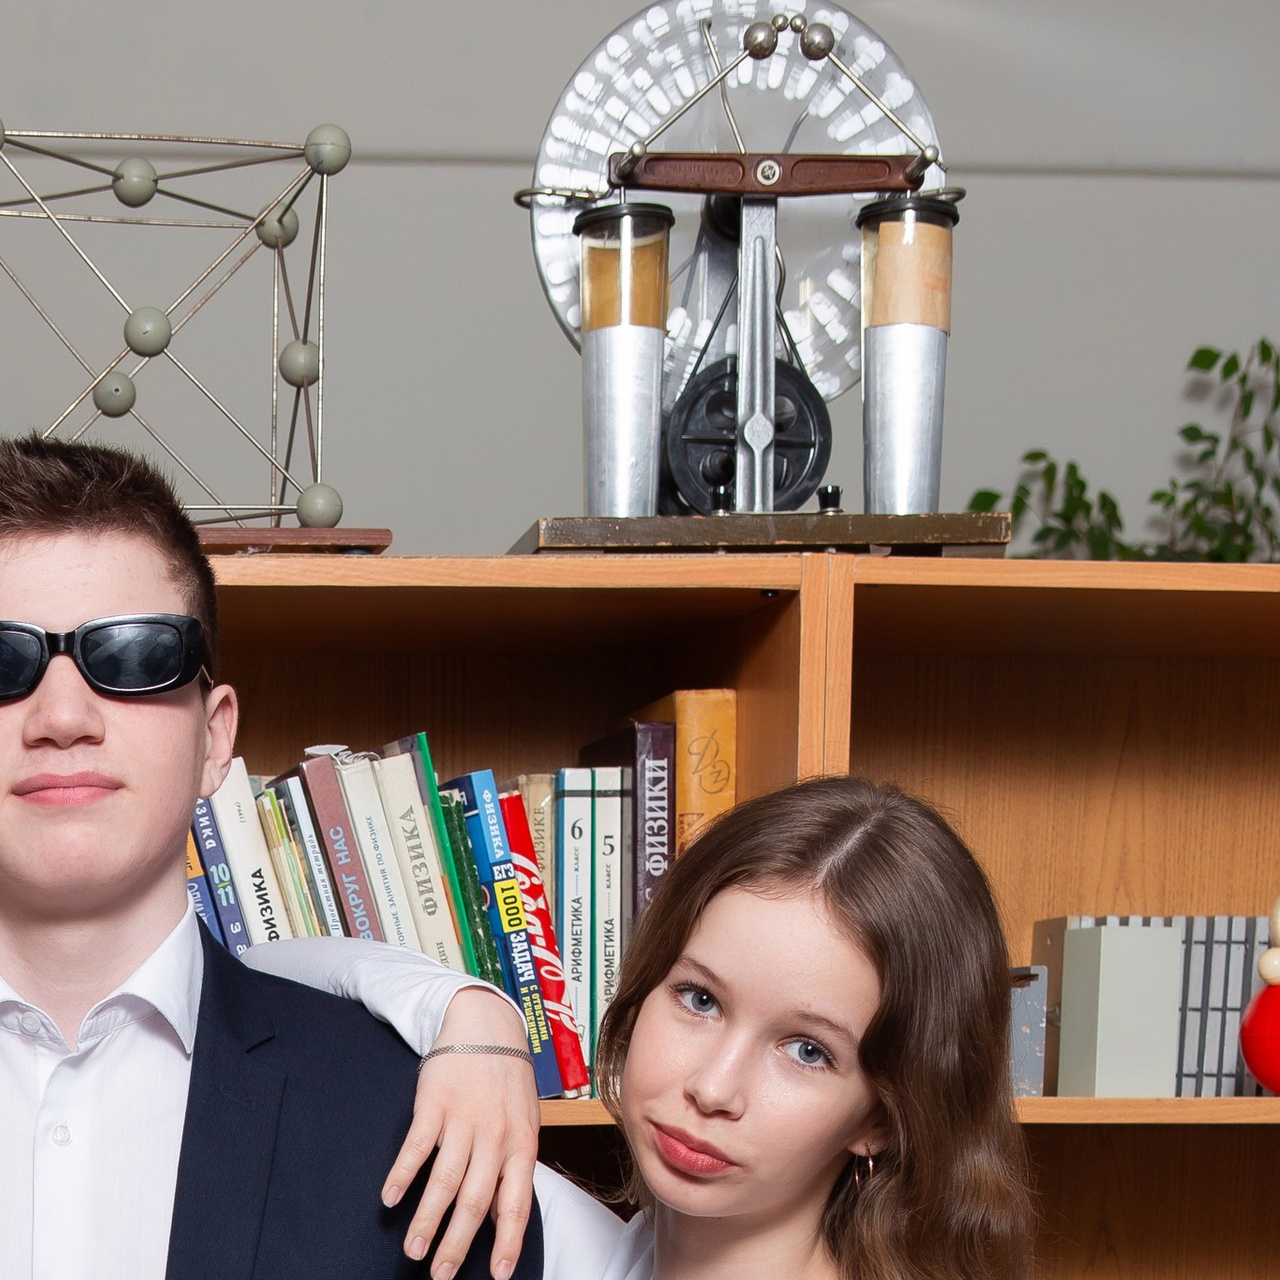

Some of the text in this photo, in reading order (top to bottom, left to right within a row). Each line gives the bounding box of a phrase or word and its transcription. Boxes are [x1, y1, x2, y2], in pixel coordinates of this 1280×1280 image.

[482, 789, 505, 859] ФИЗИКА
[570, 818, 583, 840] 6
[602, 834, 615, 856] 5
[645, 757, 669, 877] ФИЗИКИ
[210, 863, 230, 884] 10
[217, 885, 235, 906] 11
[308, 833, 340, 931] Проектная тетрадь
[329, 826, 374, 941] ВОКРУГ НАС
[365, 816, 407, 948] ТОРНЫЕ ЗАНЯТИЯ ПО ФИЗИКЕ
[399, 804, 438, 918] ФИЗИКА
[492, 862, 515, 880] ЕГЭ
[501, 885, 536, 983] 1000 ЗАДАЧ
[570, 896, 583, 983] АРИФМЕТИКА
[522, 996, 542, 1054] РЕШЕНИЯМИ
[532, 992, 549, 1041] ОТВЕТАМИ
